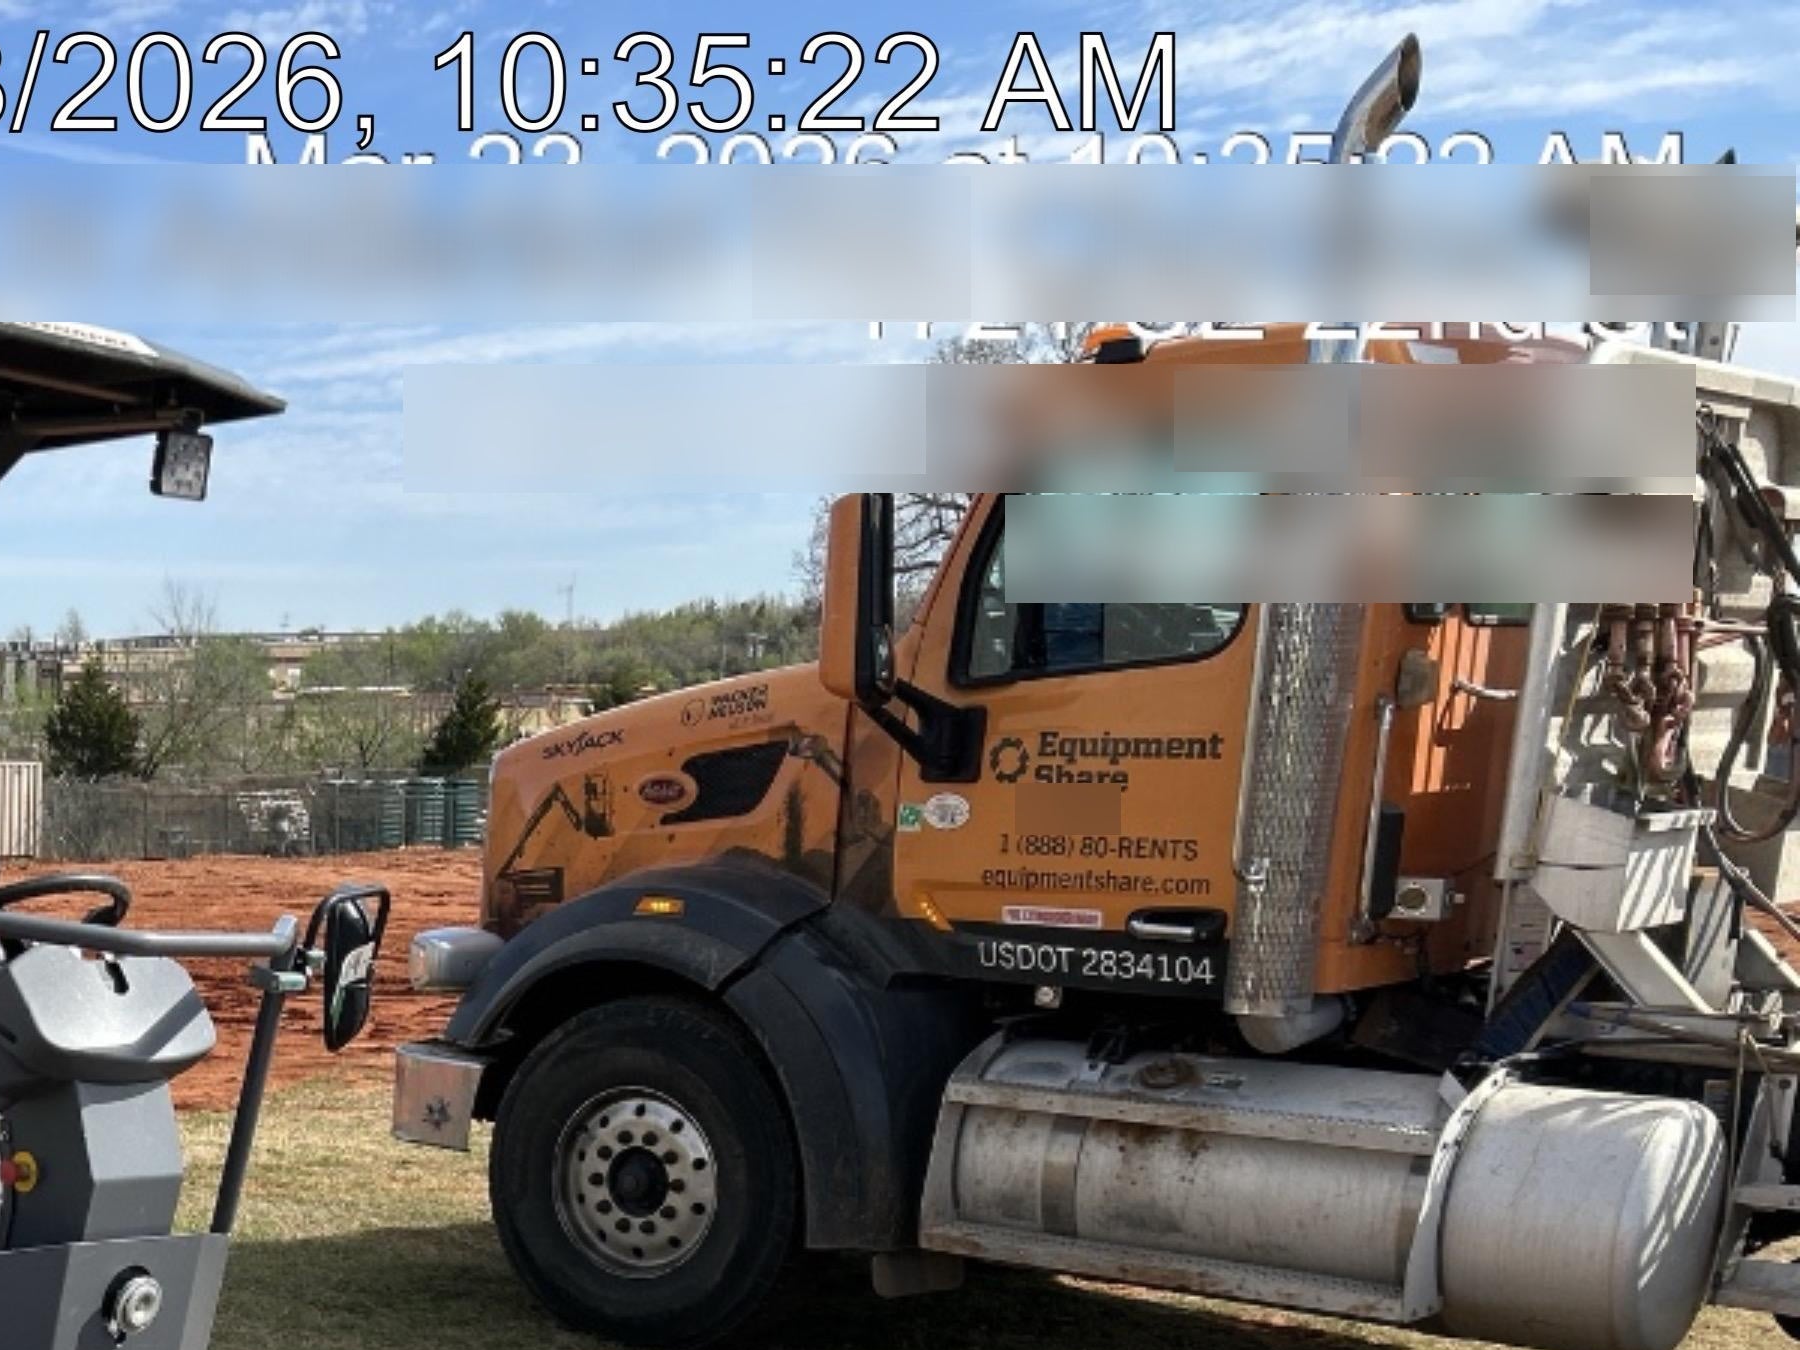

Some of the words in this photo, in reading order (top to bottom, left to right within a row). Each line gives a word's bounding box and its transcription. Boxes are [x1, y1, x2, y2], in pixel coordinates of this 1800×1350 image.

[1038, 731, 1225, 765] Equipment
[1034, 764, 1129, 792] Share
[1000, 833, 1010, 854] 1
[1079, 836, 1199, 862] 80-RENTS
[980, 866, 1211, 895] equipmentshare.com
[978, 941, 1076, 974] USDOT
[1081, 947, 1217, 985] 2834104
